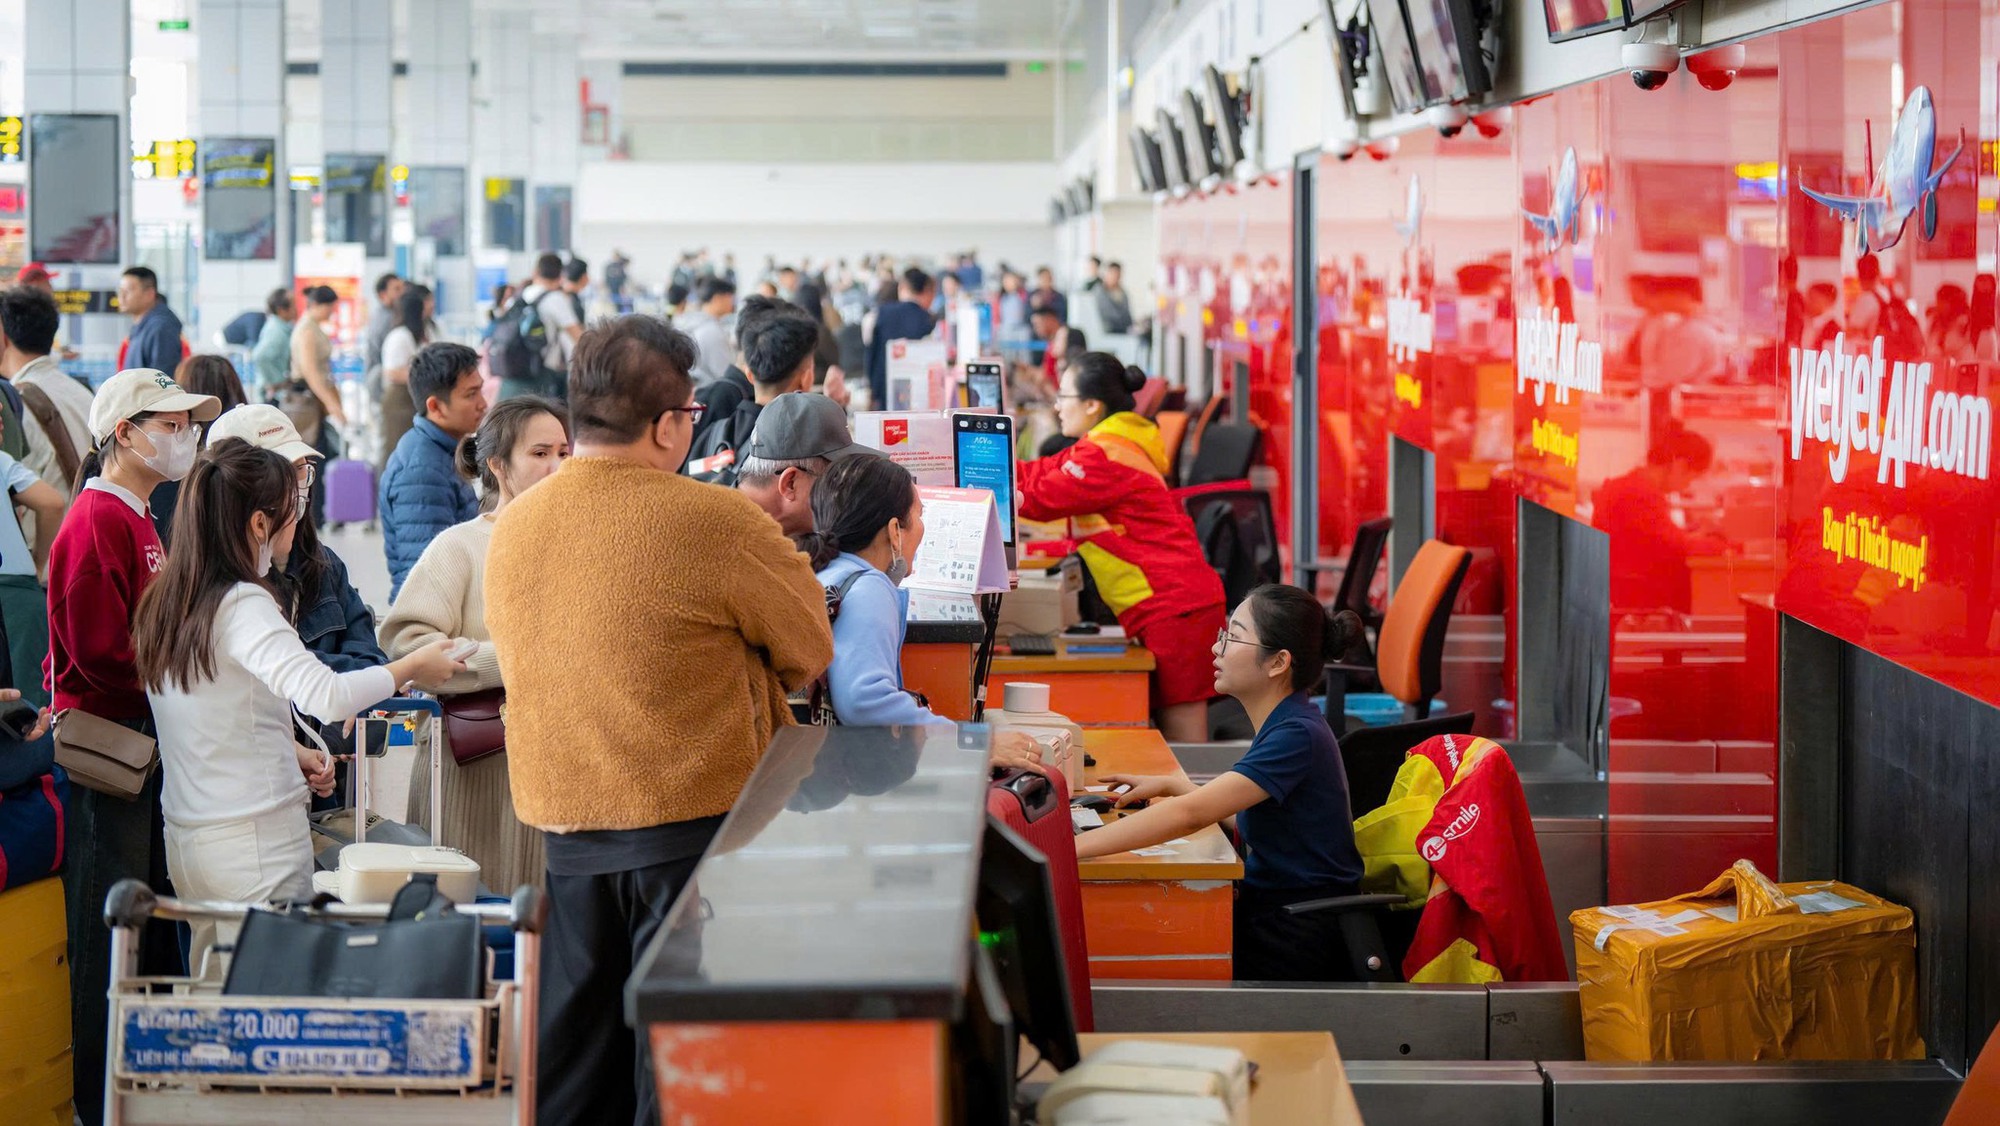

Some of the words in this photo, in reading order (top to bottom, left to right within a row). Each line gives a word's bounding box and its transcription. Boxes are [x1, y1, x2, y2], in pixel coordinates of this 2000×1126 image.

[1823, 507, 1843, 564] Bay
[1858, 516, 1890, 570] Thích
[1891, 535, 1927, 593] ngay!
[1443, 803, 1480, 838] smile
[233, 1012, 299, 1040] 20.000
